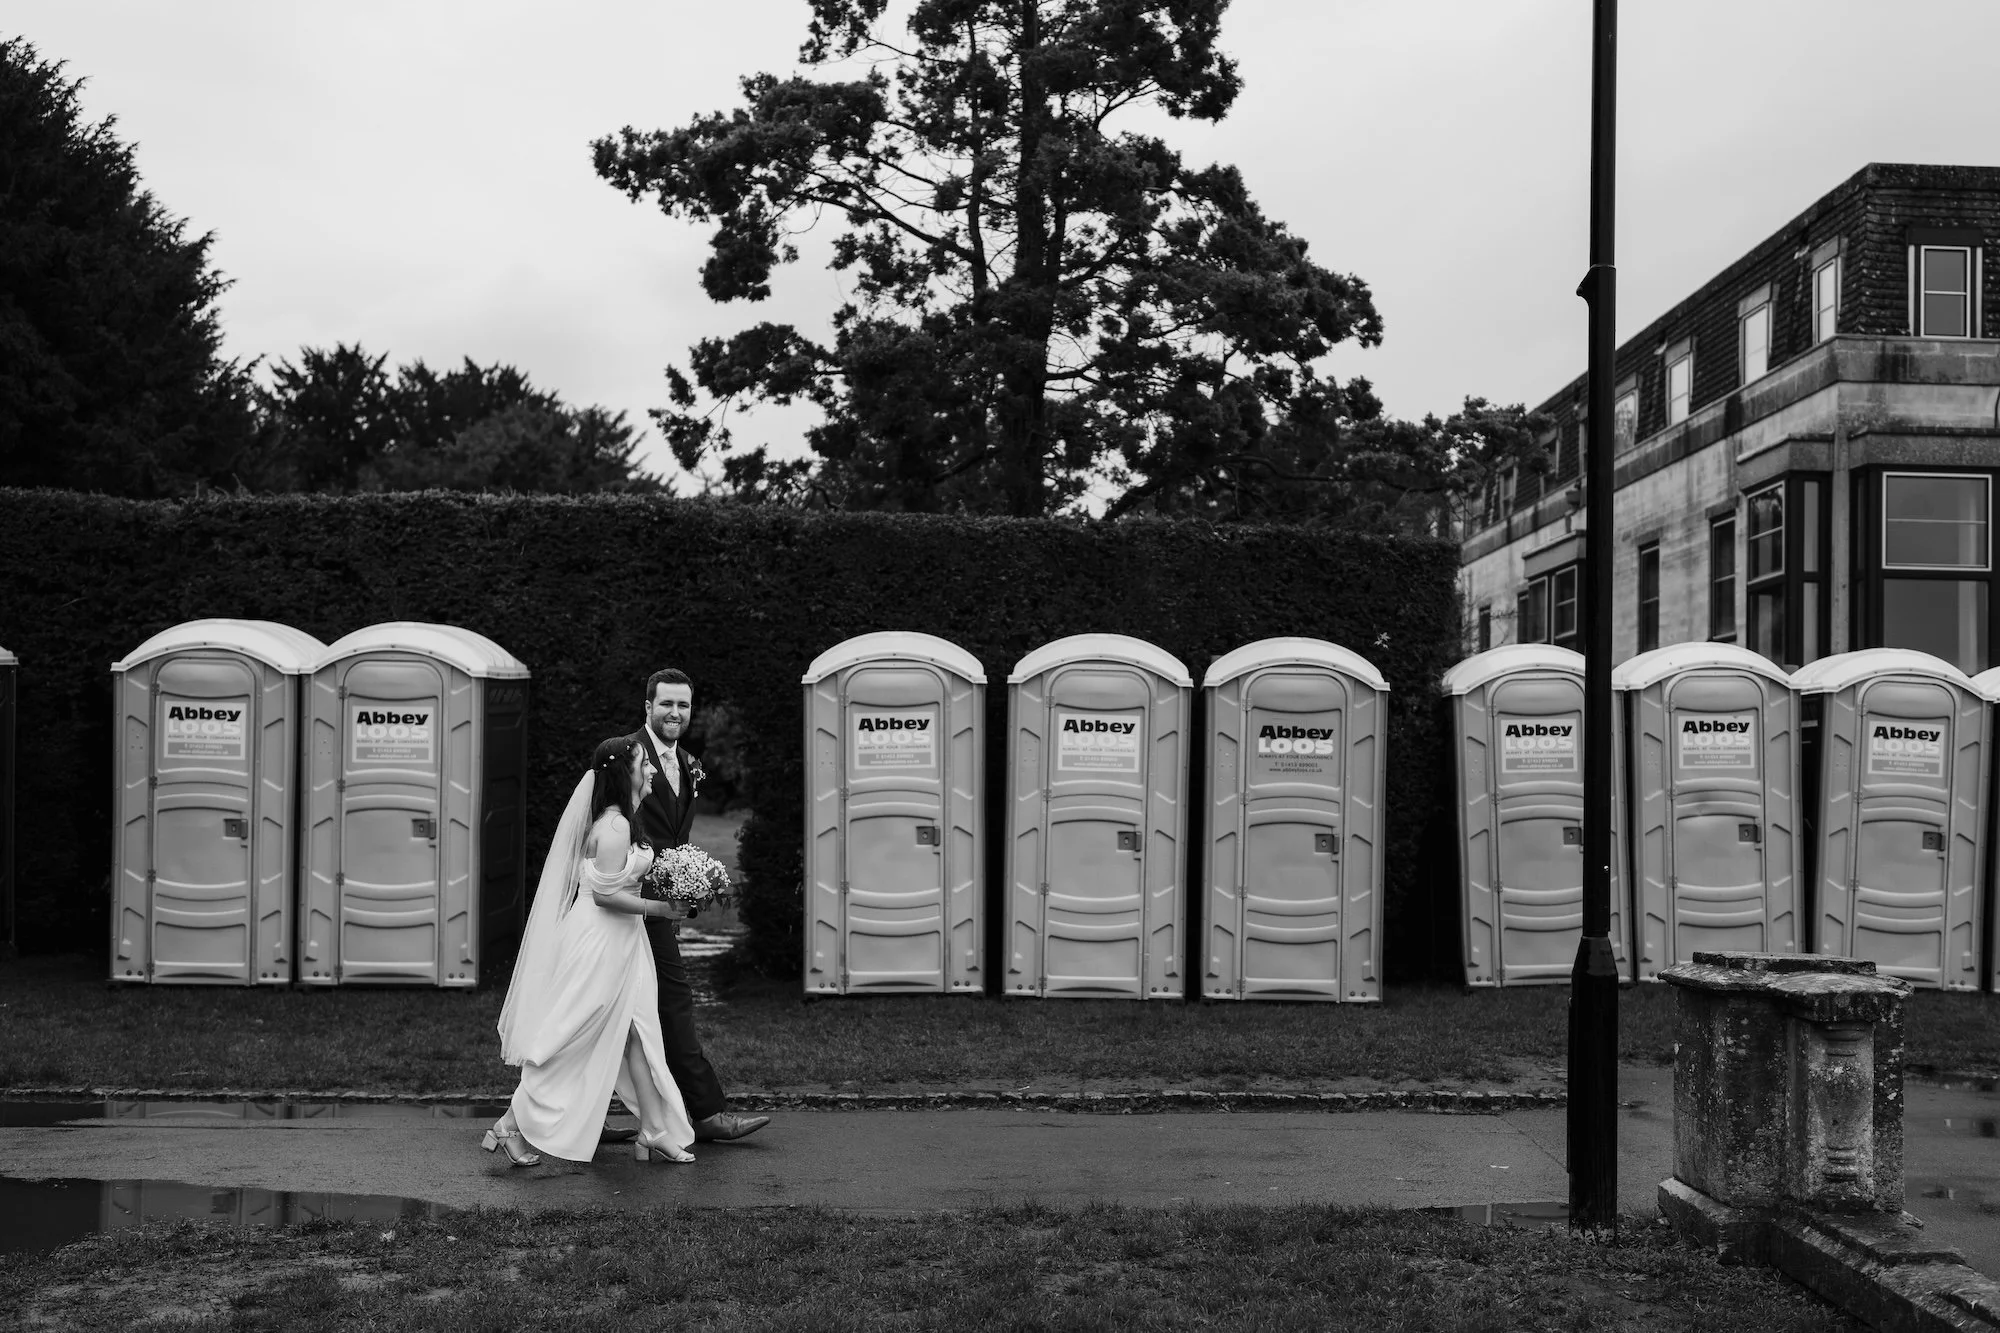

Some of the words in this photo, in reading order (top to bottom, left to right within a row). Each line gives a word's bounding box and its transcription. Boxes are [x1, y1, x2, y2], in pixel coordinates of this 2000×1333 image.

[169, 706, 242, 722] Abbey
[357, 711, 429, 726] Abbey
[168, 720, 241, 735] LOOS
[356, 724, 429, 739] LOOS
[858, 717, 930, 732] Abbey
[1063, 719, 1136, 735] Abbey
[1505, 724, 1573, 738] Abbey
[1683, 720, 1750, 734] Abbey
[858, 730, 931, 745] LOOS
[1062, 732, 1136, 748] LOOS
[1259, 725, 1334, 740] Abbey
[1682, 732, 1751, 746] LOOS
[1873, 726, 1941, 742] Abbey
[1258, 738, 1334, 755] LOOS
[1505, 736, 1574, 750] LOOS
[1872, 738, 1940, 754] LOOS
